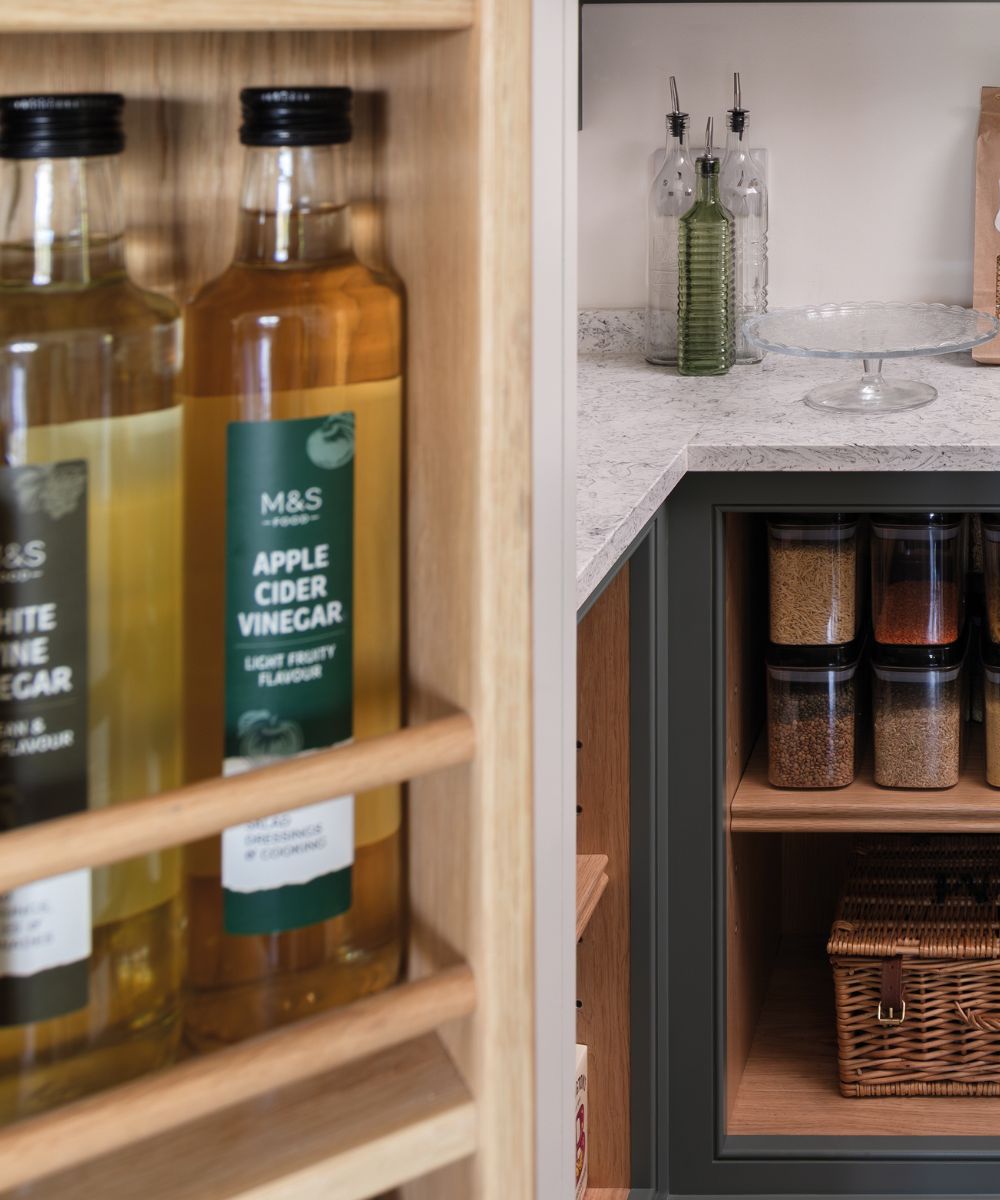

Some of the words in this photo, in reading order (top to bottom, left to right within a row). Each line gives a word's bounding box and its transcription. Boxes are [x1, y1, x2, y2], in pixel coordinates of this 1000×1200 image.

[261, 486, 323, 516] M&S
[0, 540, 47, 569] &S
[252, 543, 330, 577] APPLE
[254, 575, 328, 606] CIDER
[237, 600, 344, 638] VINEGAR
[244, 654, 284, 672] LIGHT
[287, 644, 336, 665] FRUITY
[258, 664, 323, 688] FLAVOUR
